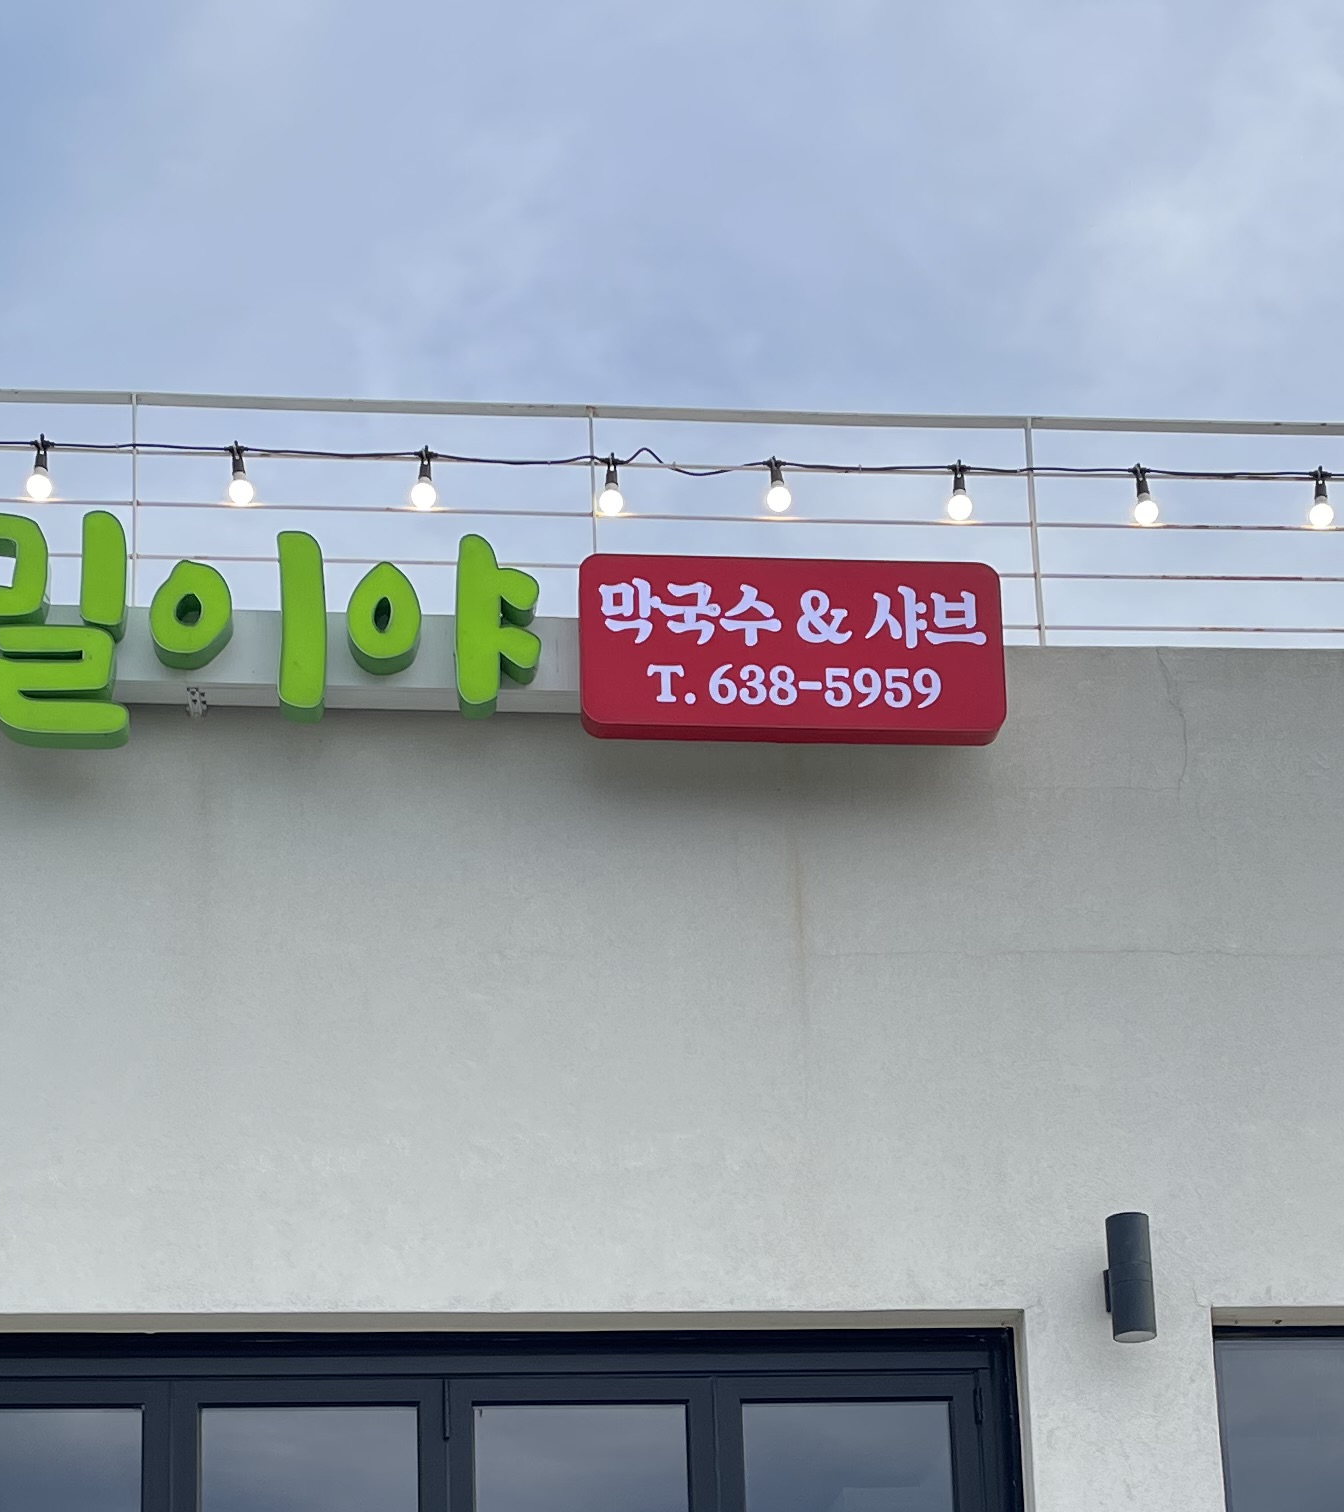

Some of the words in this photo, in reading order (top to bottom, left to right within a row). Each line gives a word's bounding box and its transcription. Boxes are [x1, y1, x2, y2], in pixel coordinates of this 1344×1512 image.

[598, 577, 782, 647] 막국수
[796, 589, 853, 645] &
[864, 585, 987, 649] 샤브
[647, 664, 696, 705] T.
[708, 664, 942, 709] 638-5959
